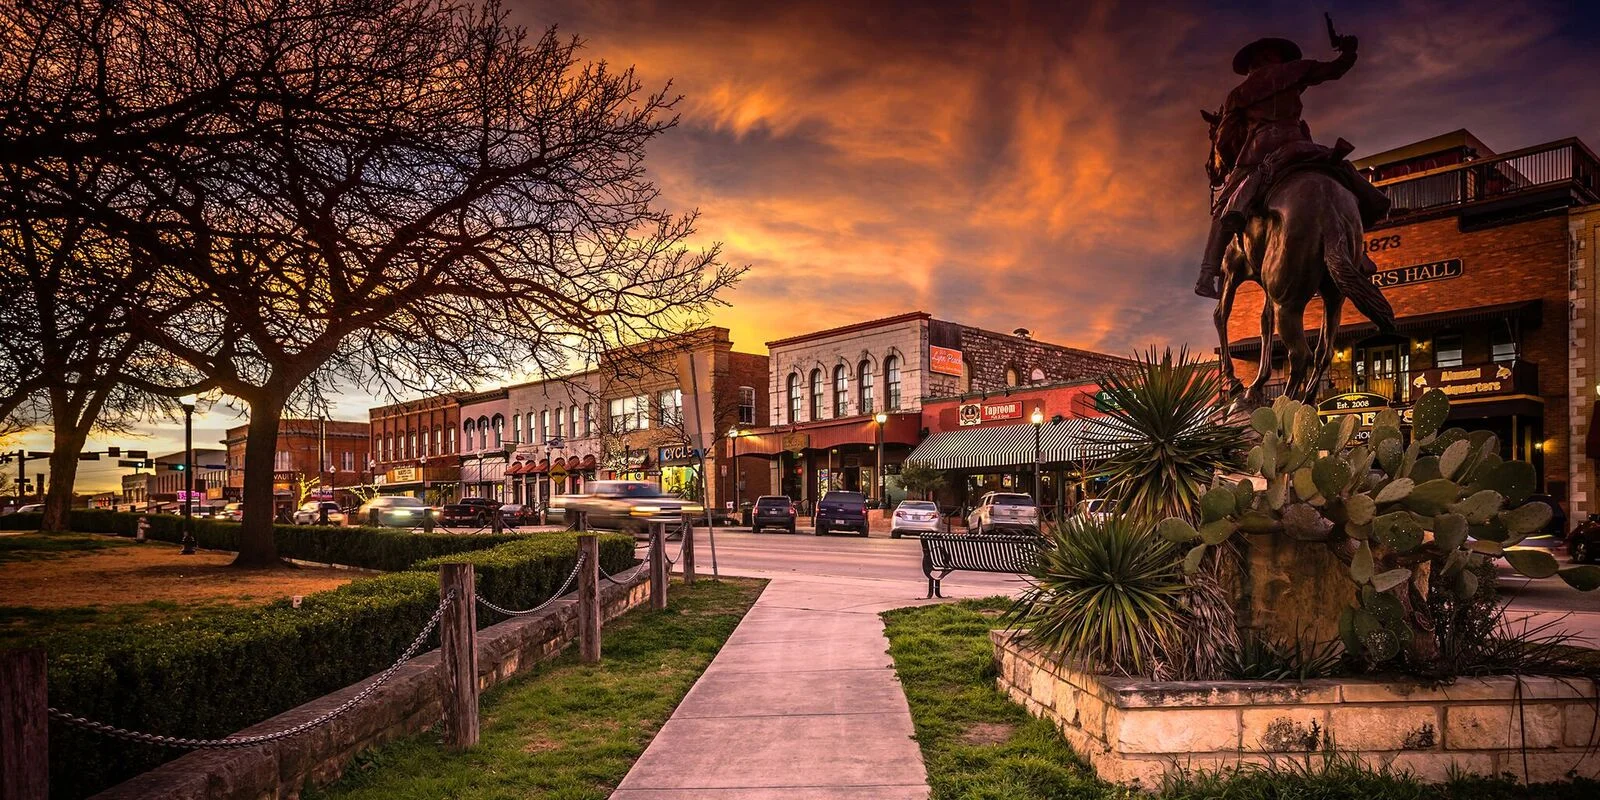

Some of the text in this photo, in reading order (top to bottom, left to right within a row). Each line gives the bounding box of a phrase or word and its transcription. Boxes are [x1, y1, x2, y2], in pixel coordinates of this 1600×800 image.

[1363, 235, 1401, 254] 1873
[1405, 262, 1456, 282] HALL
[984, 404, 1016, 416] Taproom
[1351, 400, 1370, 408] 2008
